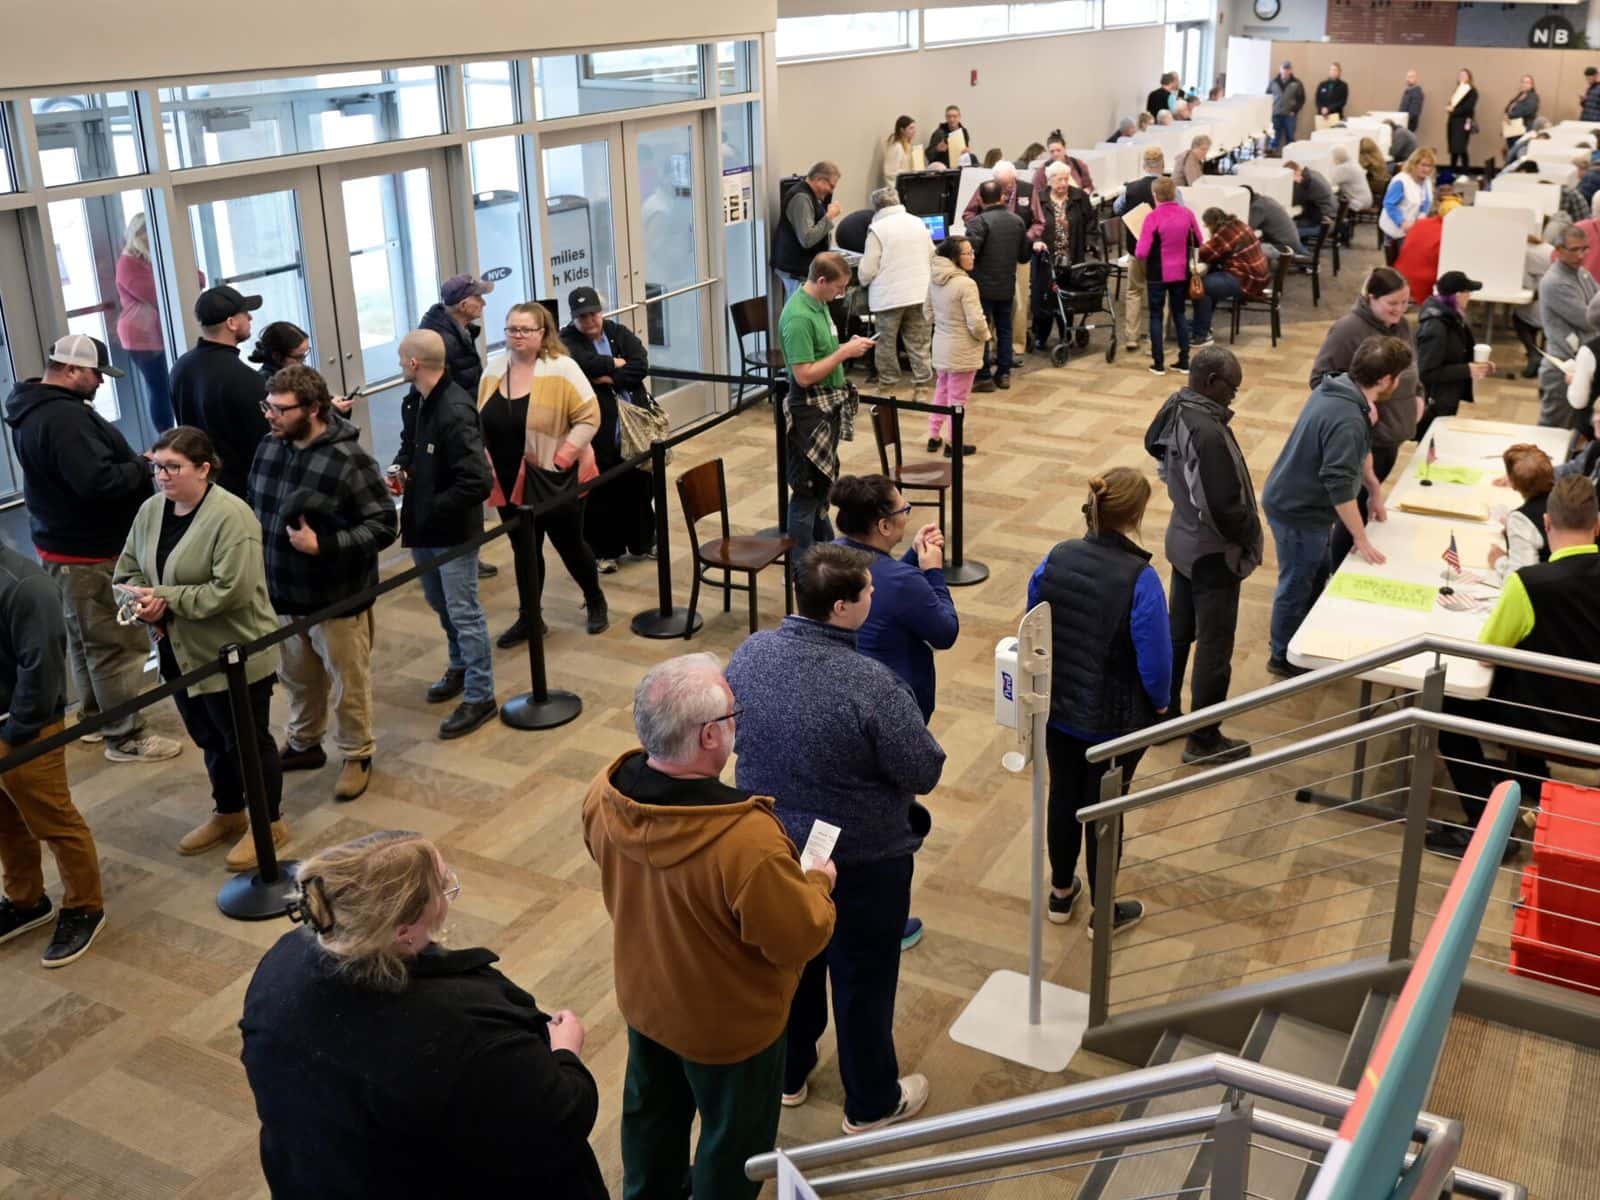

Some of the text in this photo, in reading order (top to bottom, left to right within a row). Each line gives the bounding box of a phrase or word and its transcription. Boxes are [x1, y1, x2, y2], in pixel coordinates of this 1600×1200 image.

[550, 248, 586, 267] milies
[487, 268, 507, 281] NVC
[563, 266, 590, 284] Kids
